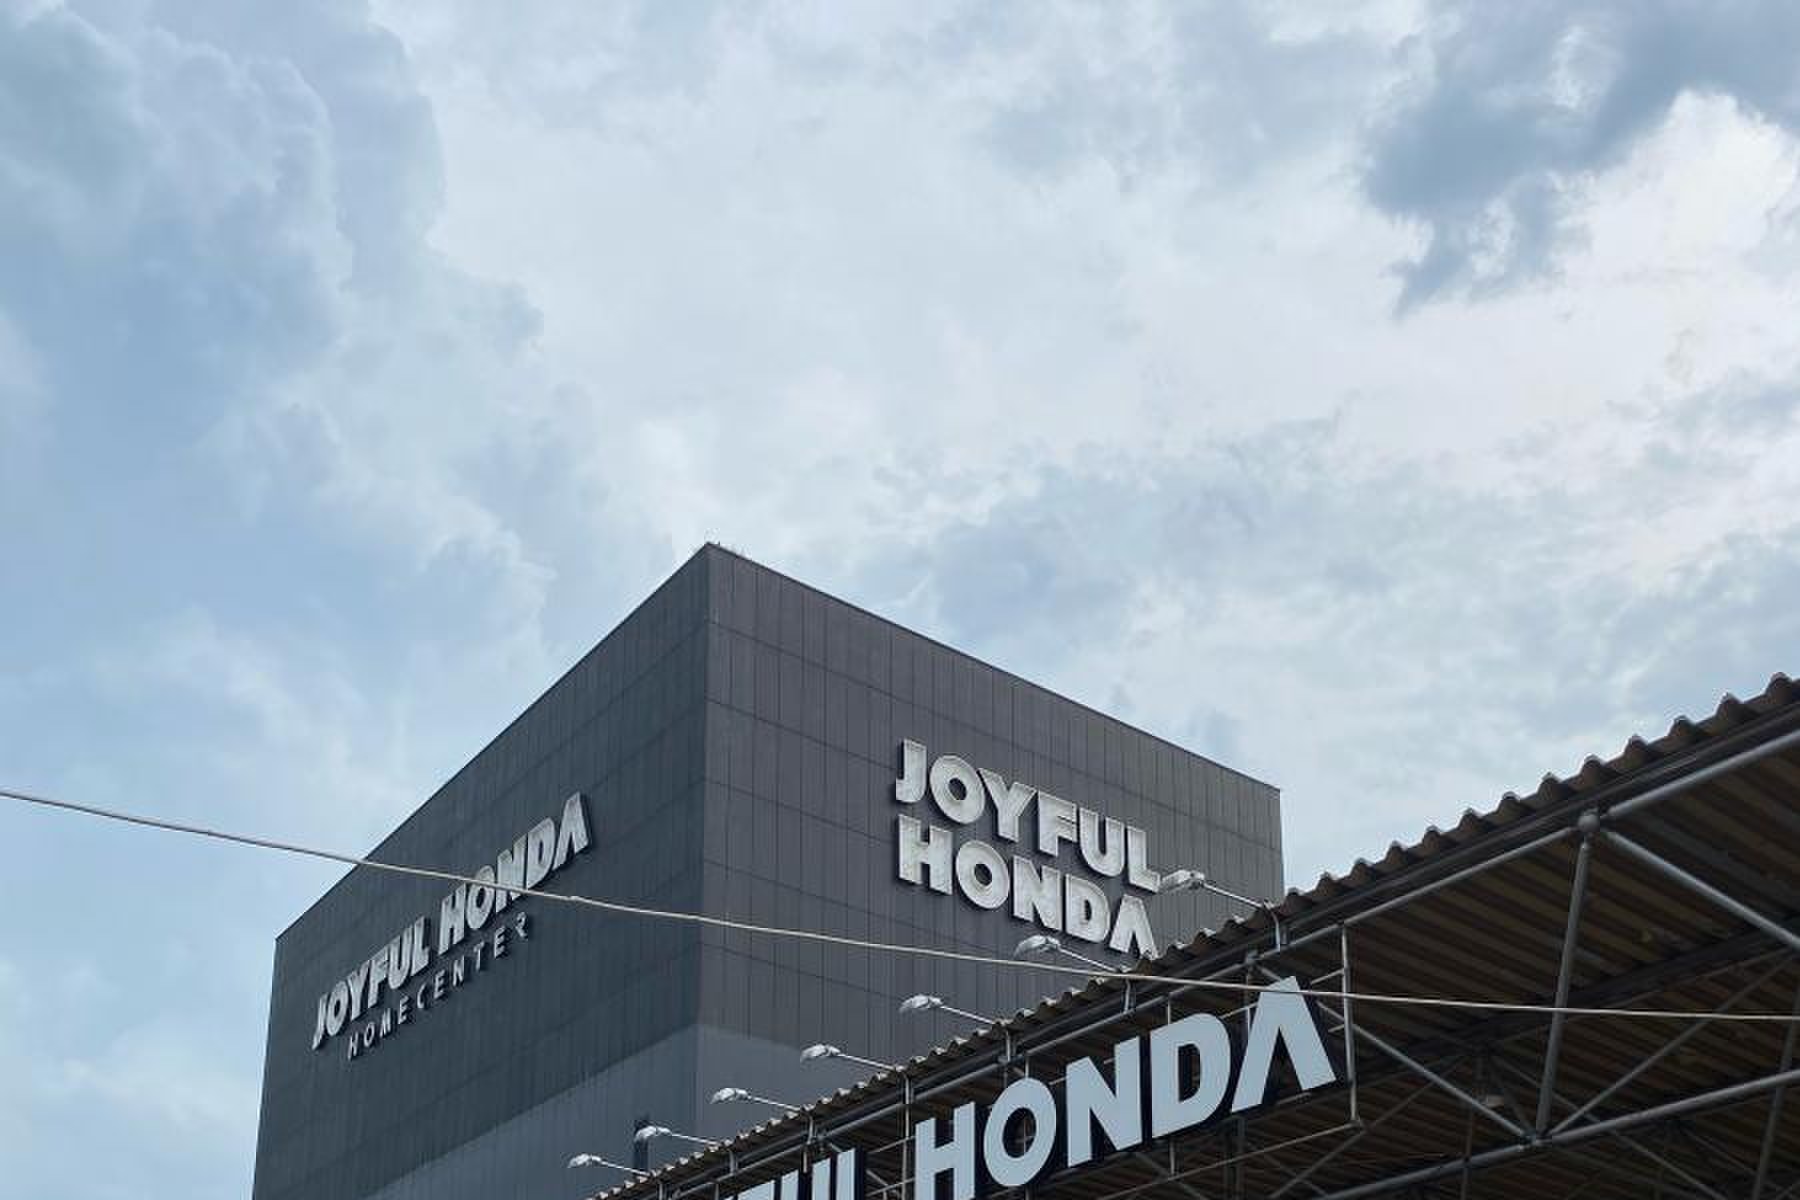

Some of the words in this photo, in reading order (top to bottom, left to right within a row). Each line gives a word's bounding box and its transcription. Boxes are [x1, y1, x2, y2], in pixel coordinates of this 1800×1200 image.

[896, 738, 1160, 893] JOYFUL
[898, 814, 1158, 961] HONDA
[312, 916, 429, 1050] JOYFUL
[438, 792, 589, 955] HONDA
